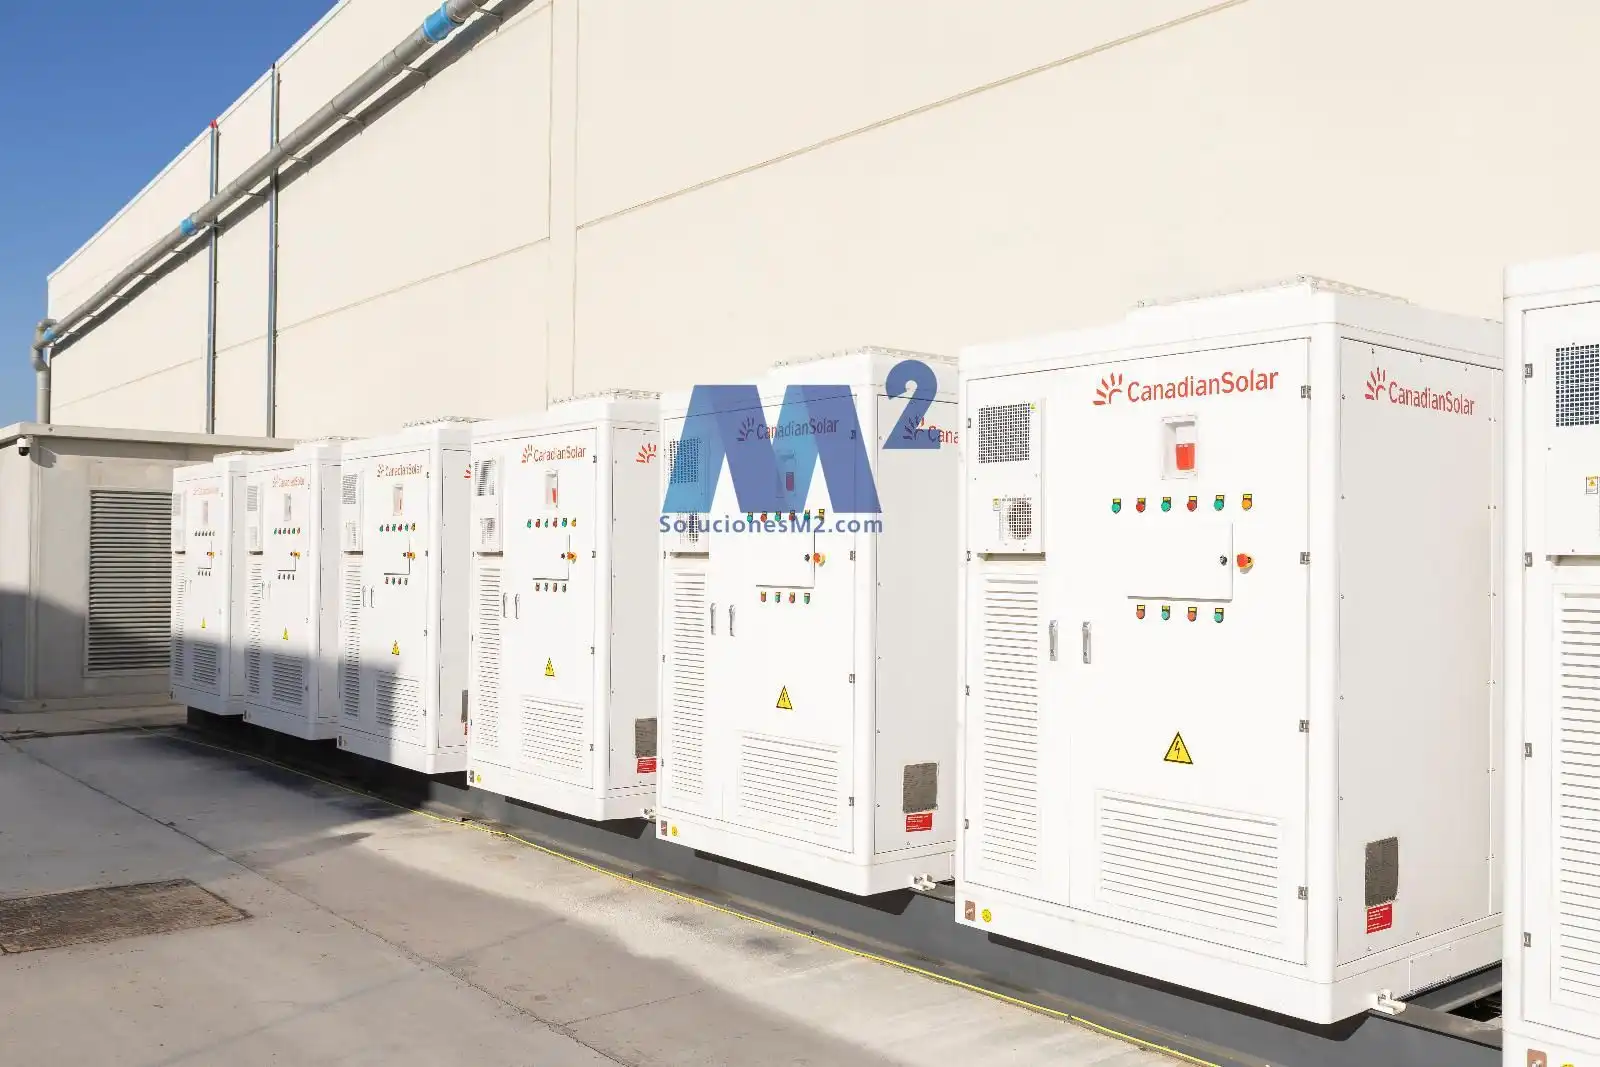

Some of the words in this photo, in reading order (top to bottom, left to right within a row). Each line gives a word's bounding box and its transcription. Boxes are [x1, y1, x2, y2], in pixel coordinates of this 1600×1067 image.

[1127, 368, 1279, 402] CanadianSolar
[1388, 381, 1475, 416] CanadianSolar
[756, 418, 840, 440] CanadianSolar
